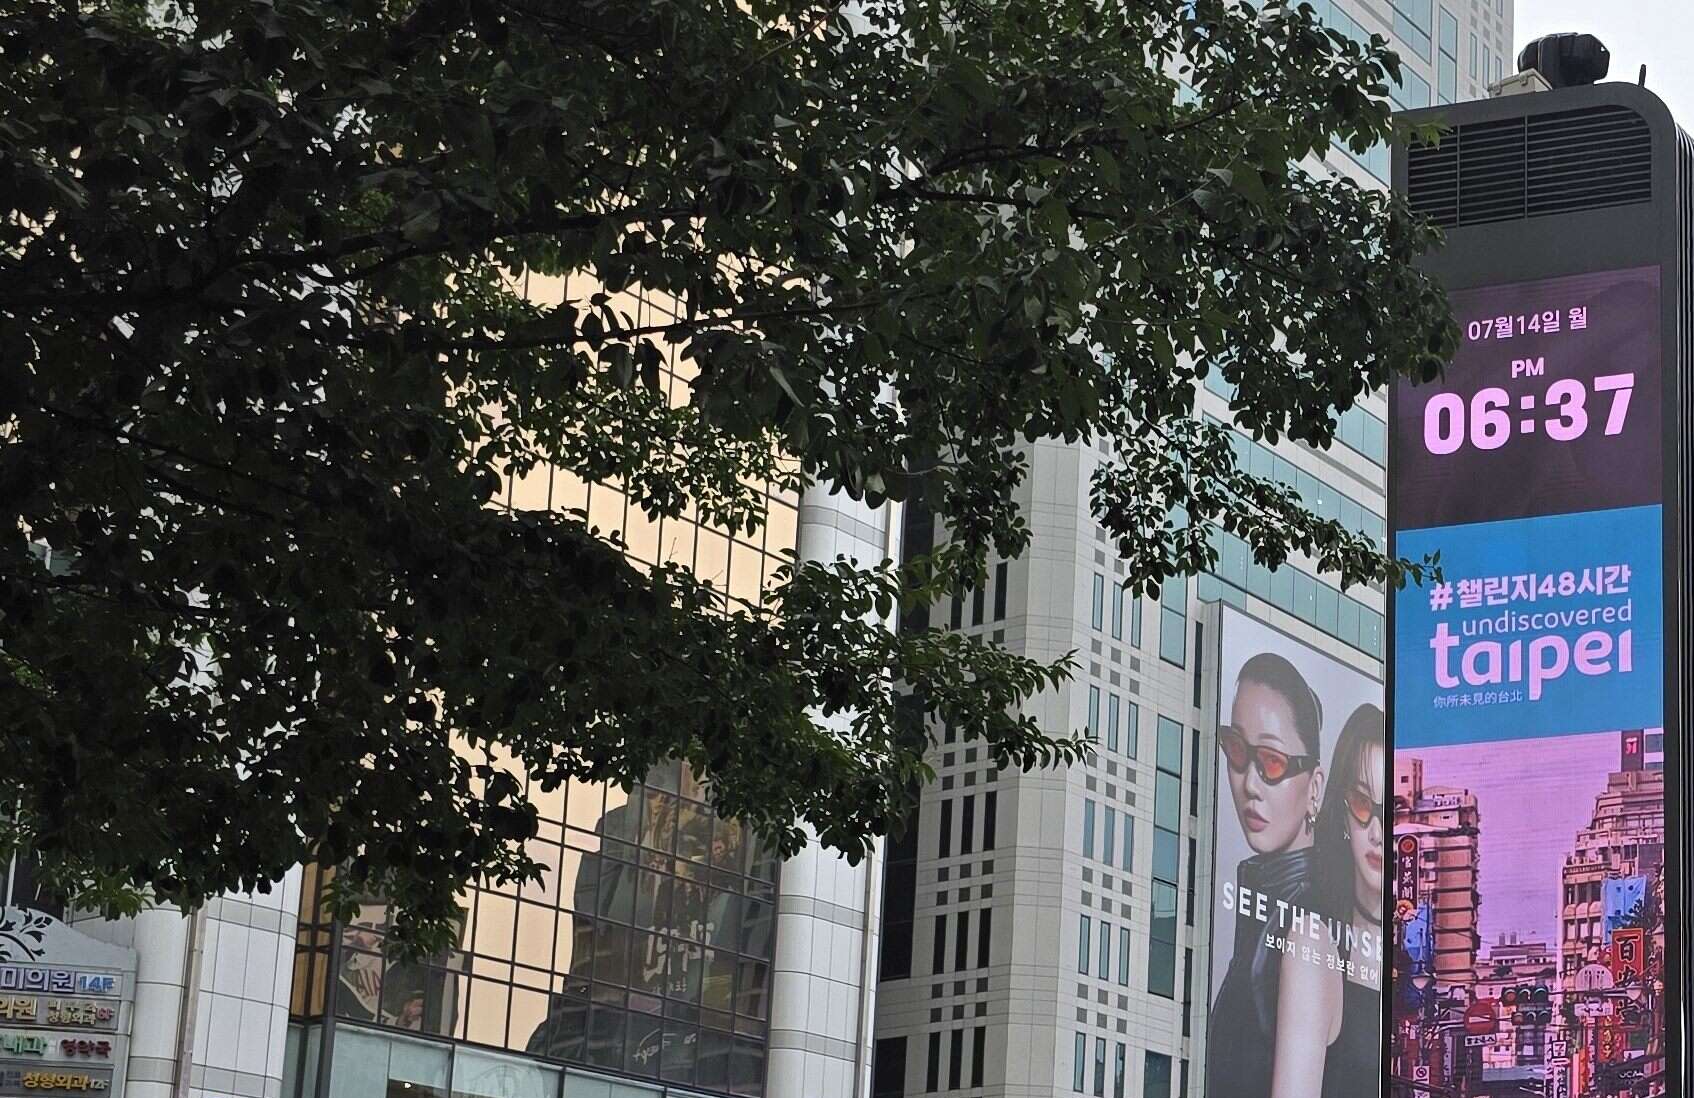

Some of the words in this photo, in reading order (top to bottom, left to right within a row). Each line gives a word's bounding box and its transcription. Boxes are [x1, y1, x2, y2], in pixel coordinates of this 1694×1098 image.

[1468, 309, 1561, 341] 07월14일
[1568, 306, 1588, 332] 월
[1511, 357, 1545, 378] PM
[1424, 373, 1635, 455] 06:37
[1430, 565, 1632, 611] #챌린지48시간
[1463, 599, 1632, 637] undiscovered
[1430, 622, 1633, 701] taipei
[1223, 881, 1268, 922] SEE
[1276, 899, 1321, 940] THE
[1265, 933, 1296, 957] 보이지
